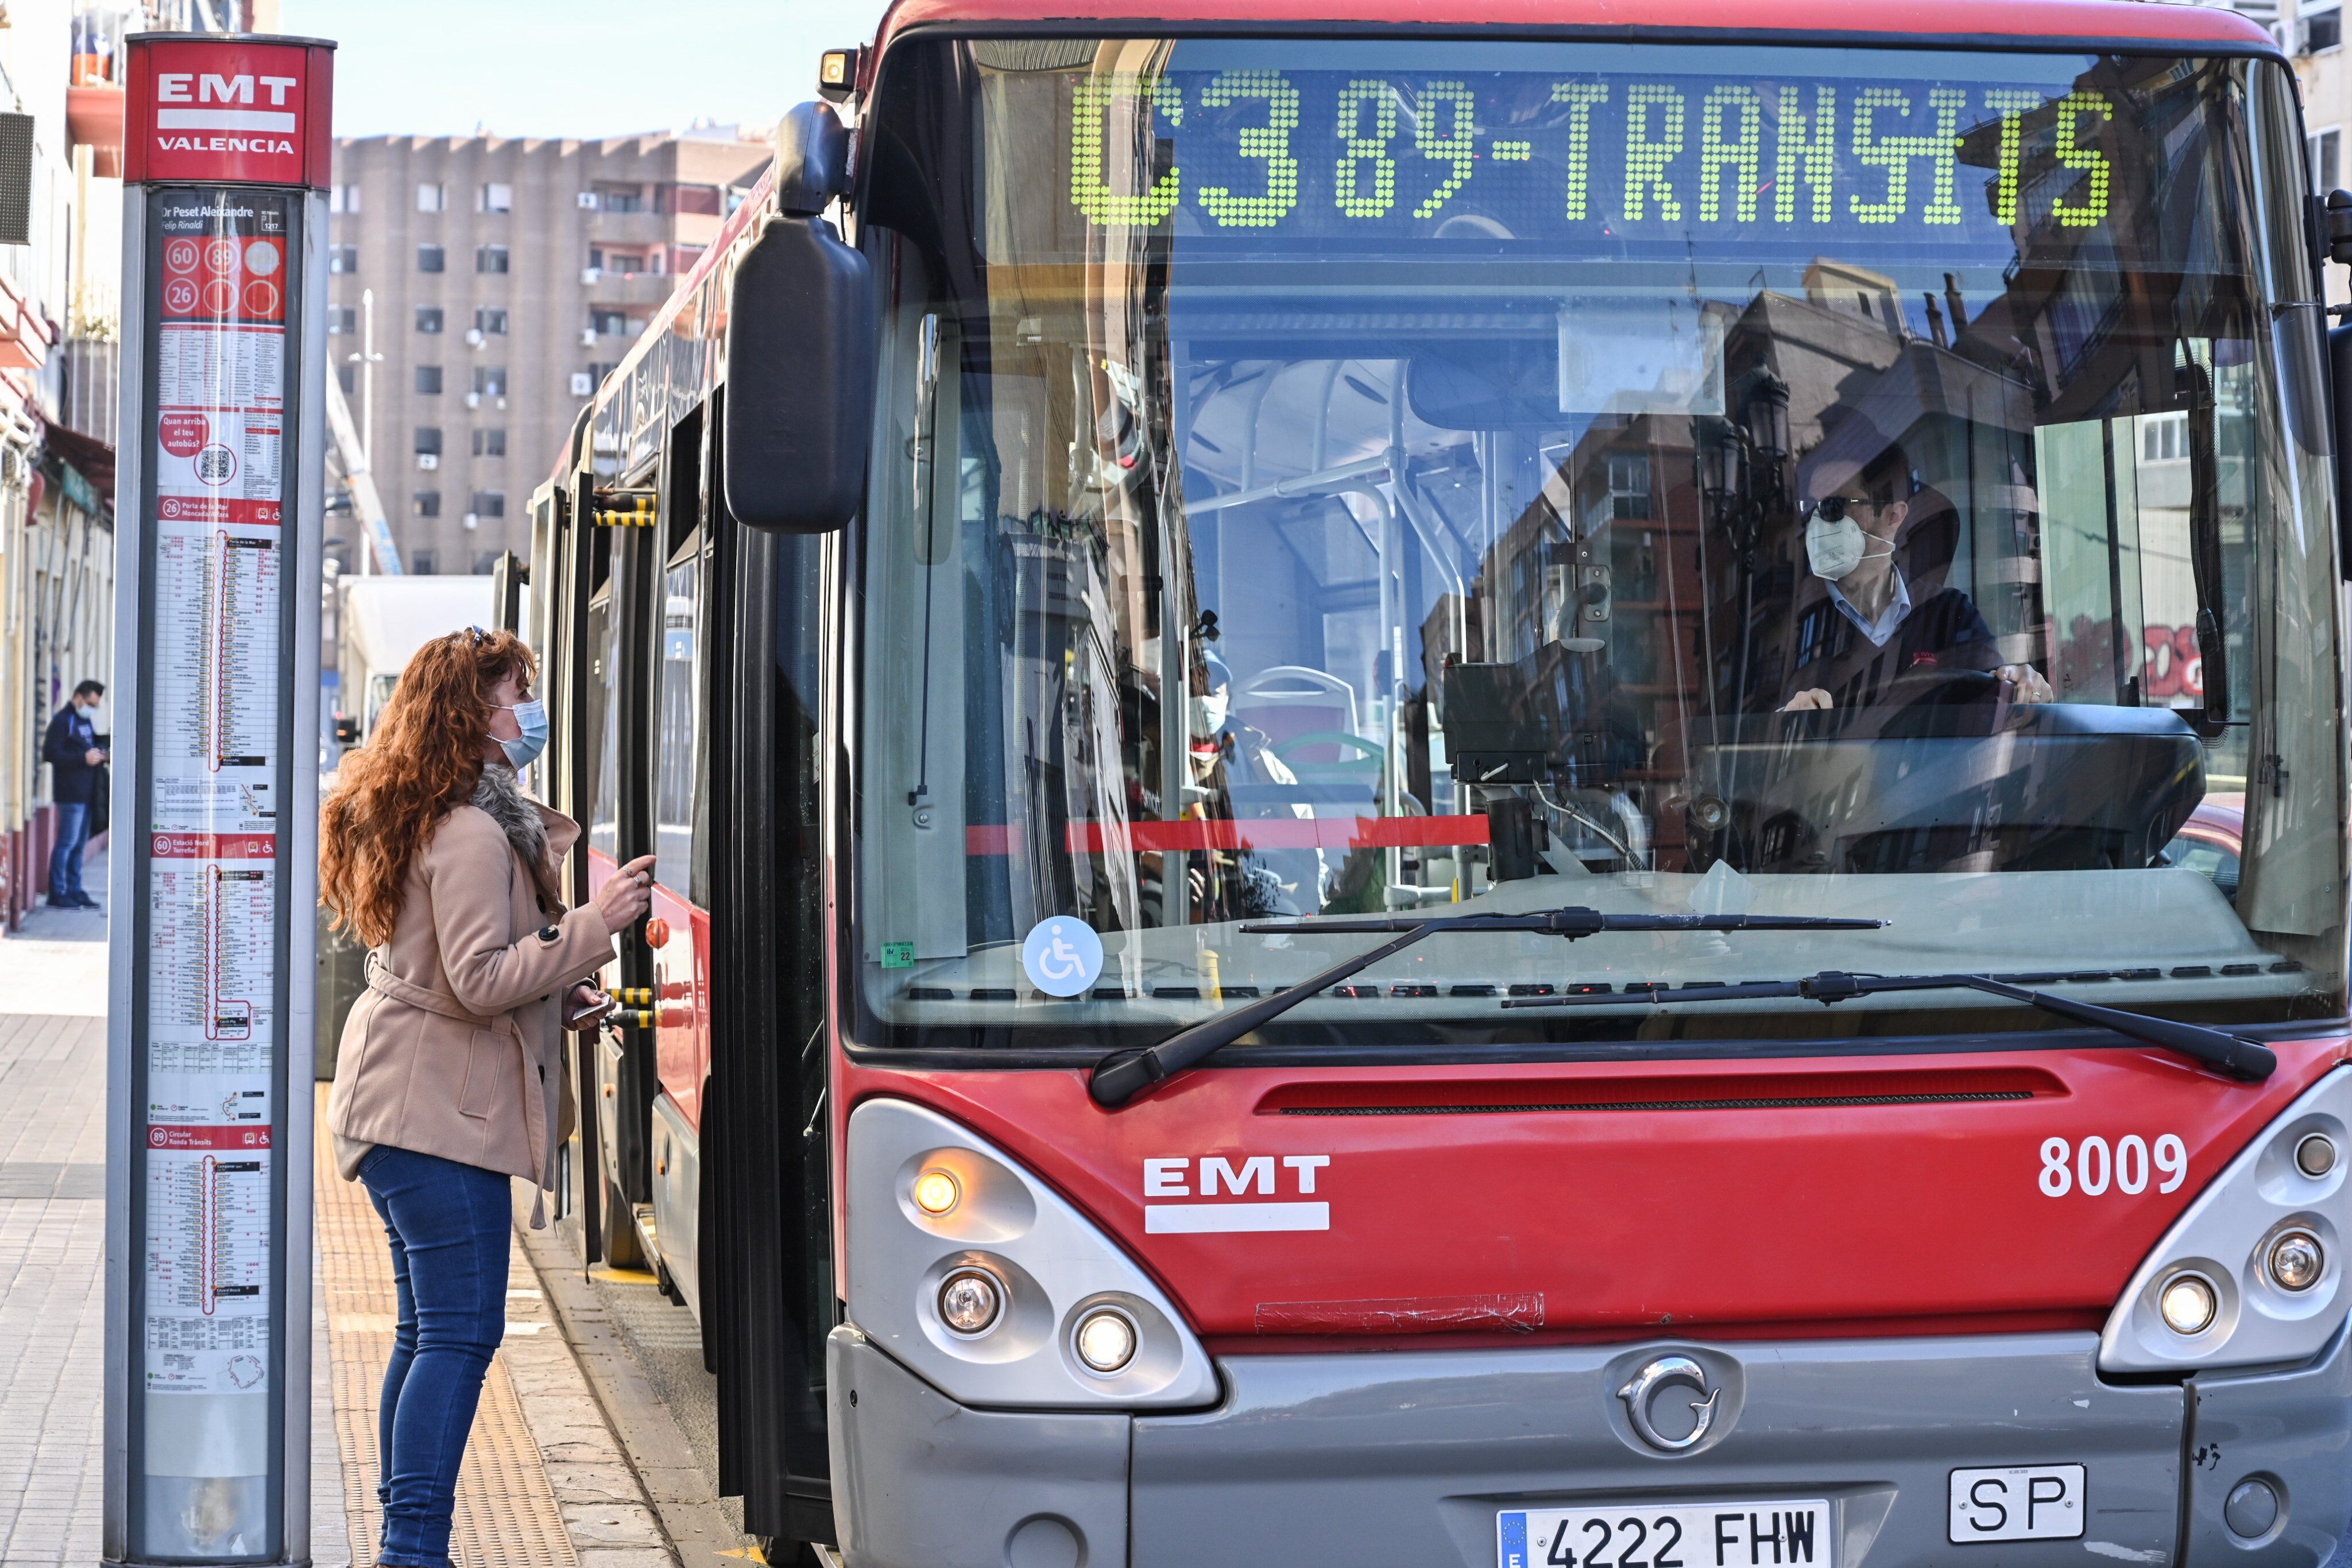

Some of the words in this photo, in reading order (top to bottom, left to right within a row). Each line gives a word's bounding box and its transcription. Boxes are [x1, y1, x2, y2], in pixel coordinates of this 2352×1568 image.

[158, 73, 296, 106] EMT
[157, 137, 294, 154] VALENCIA
[1070, 69, 1299, 227] C3
[162, 207, 172, 217] Dr
[173, 207, 198, 217] Peset
[200, 206, 253, 217] Aleixandre
[161, 221, 177, 231] Felip
[178, 220, 203, 229] Rinaldi
[173, 247, 192, 264] 60
[212, 249, 231, 266] 89
[172, 287, 191, 303] 26
[183, 417, 206, 425] arriba
[166, 504, 177, 512] 26
[157, 841, 167, 850] 60
[901, 952, 911, 961] 22
[153, 1133, 164, 1141] 89
[2038, 1134, 2187, 1197] 8009
[1144, 1155, 1330, 1196] EMT
[1970, 1476, 2066, 1531] SP
[1547, 1516, 1683, 1568] 4222
[1715, 1511, 1815, 1566] FHW
